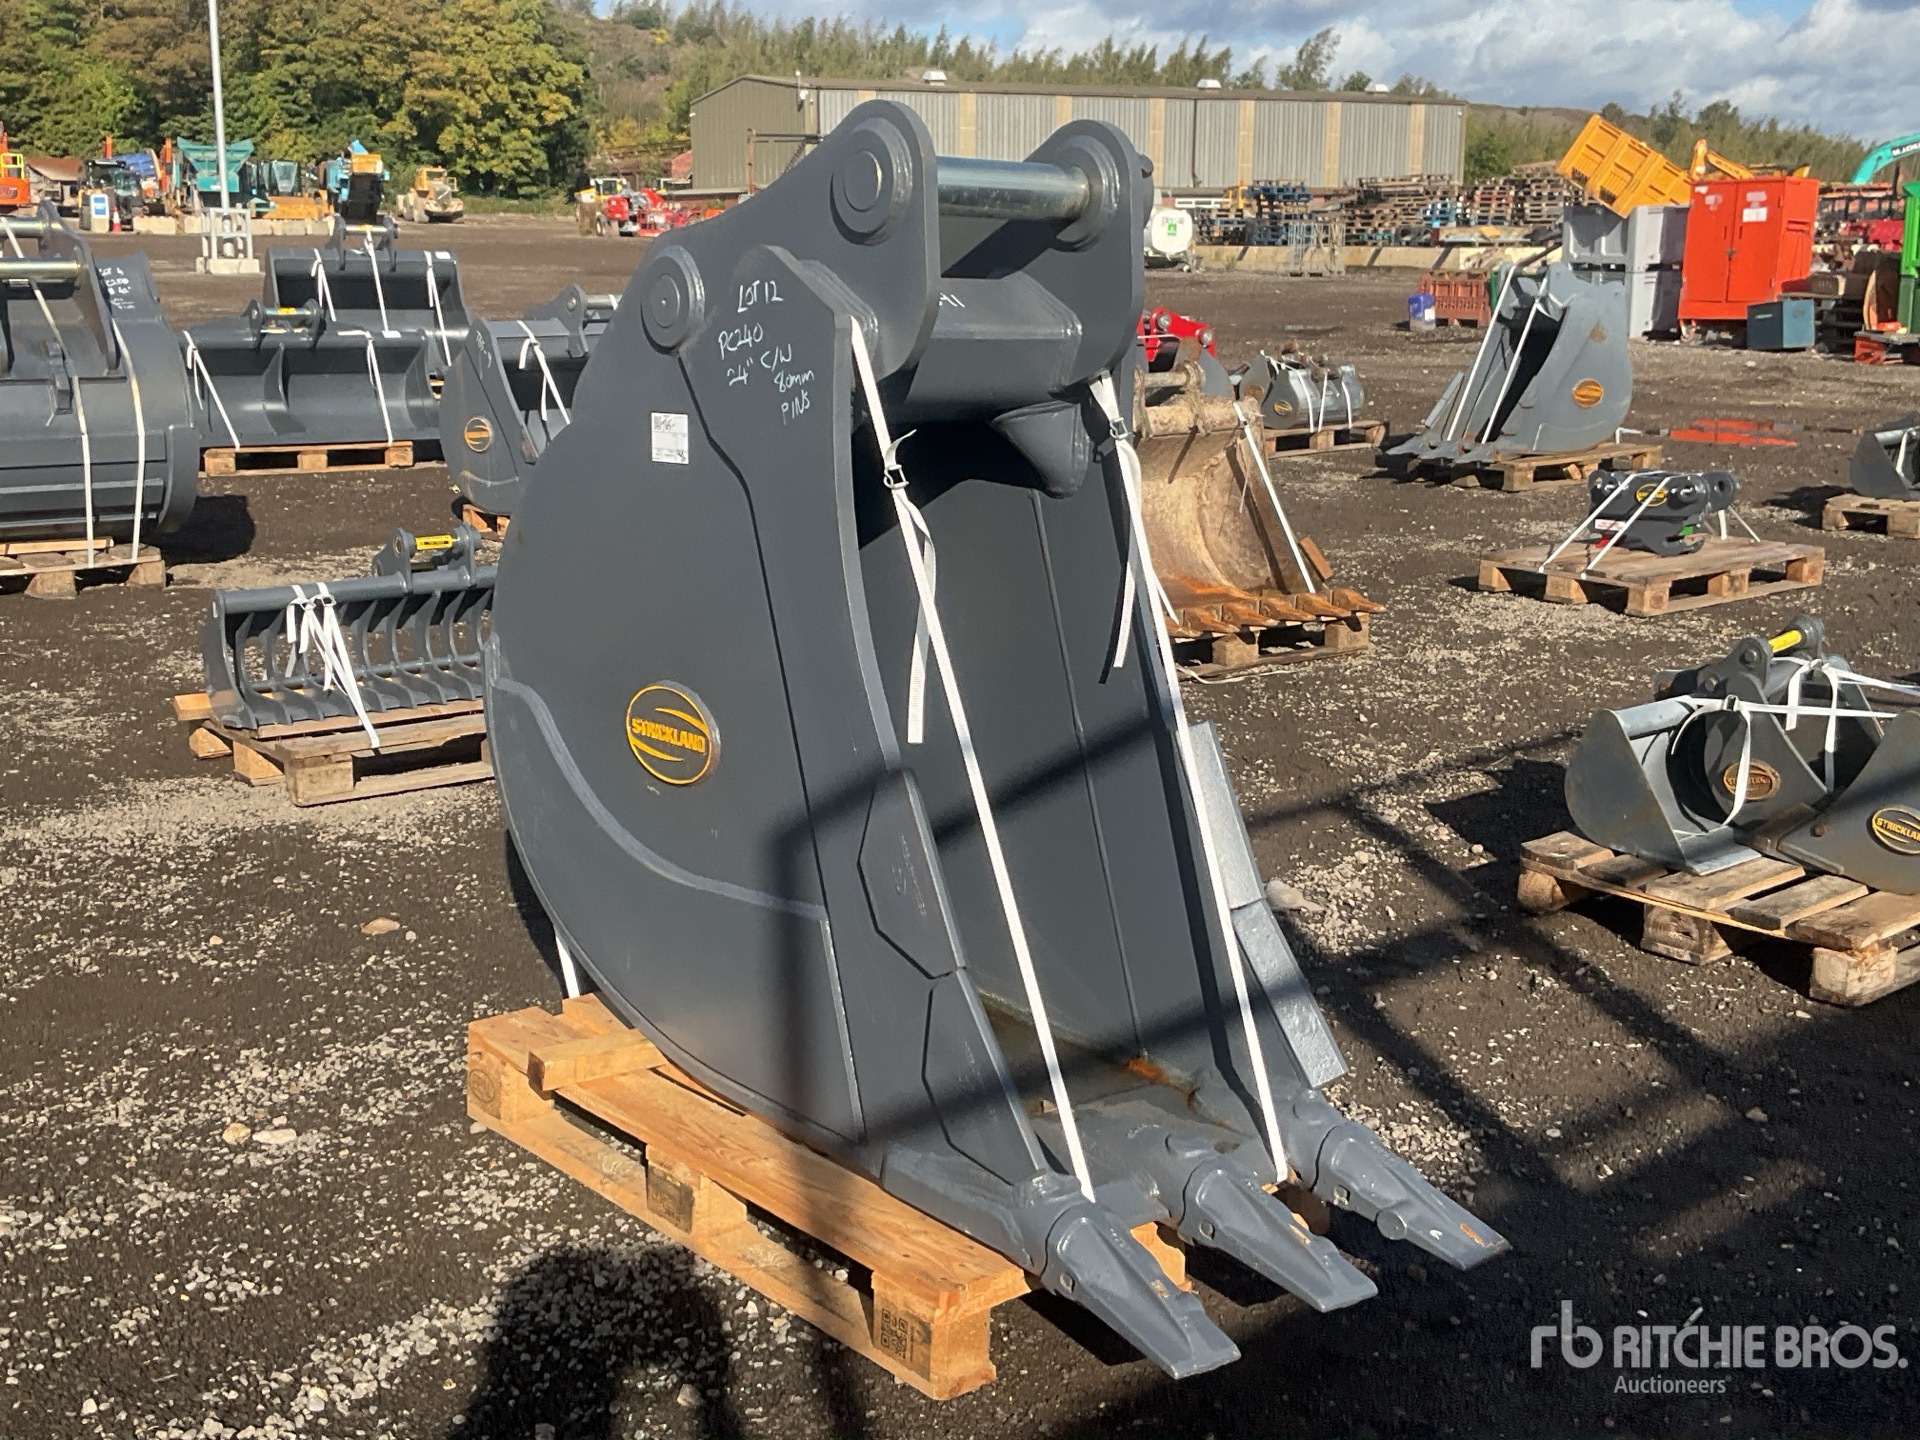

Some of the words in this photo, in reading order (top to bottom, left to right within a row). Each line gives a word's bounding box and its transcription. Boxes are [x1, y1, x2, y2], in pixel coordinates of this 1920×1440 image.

[737, 280, 761, 313] LOT
[765, 280, 784, 304] 12
[718, 322, 764, 360] PC240
[631, 717, 706, 753] STRICKLAND
[1875, 817, 1920, 842] STRICKLAN
